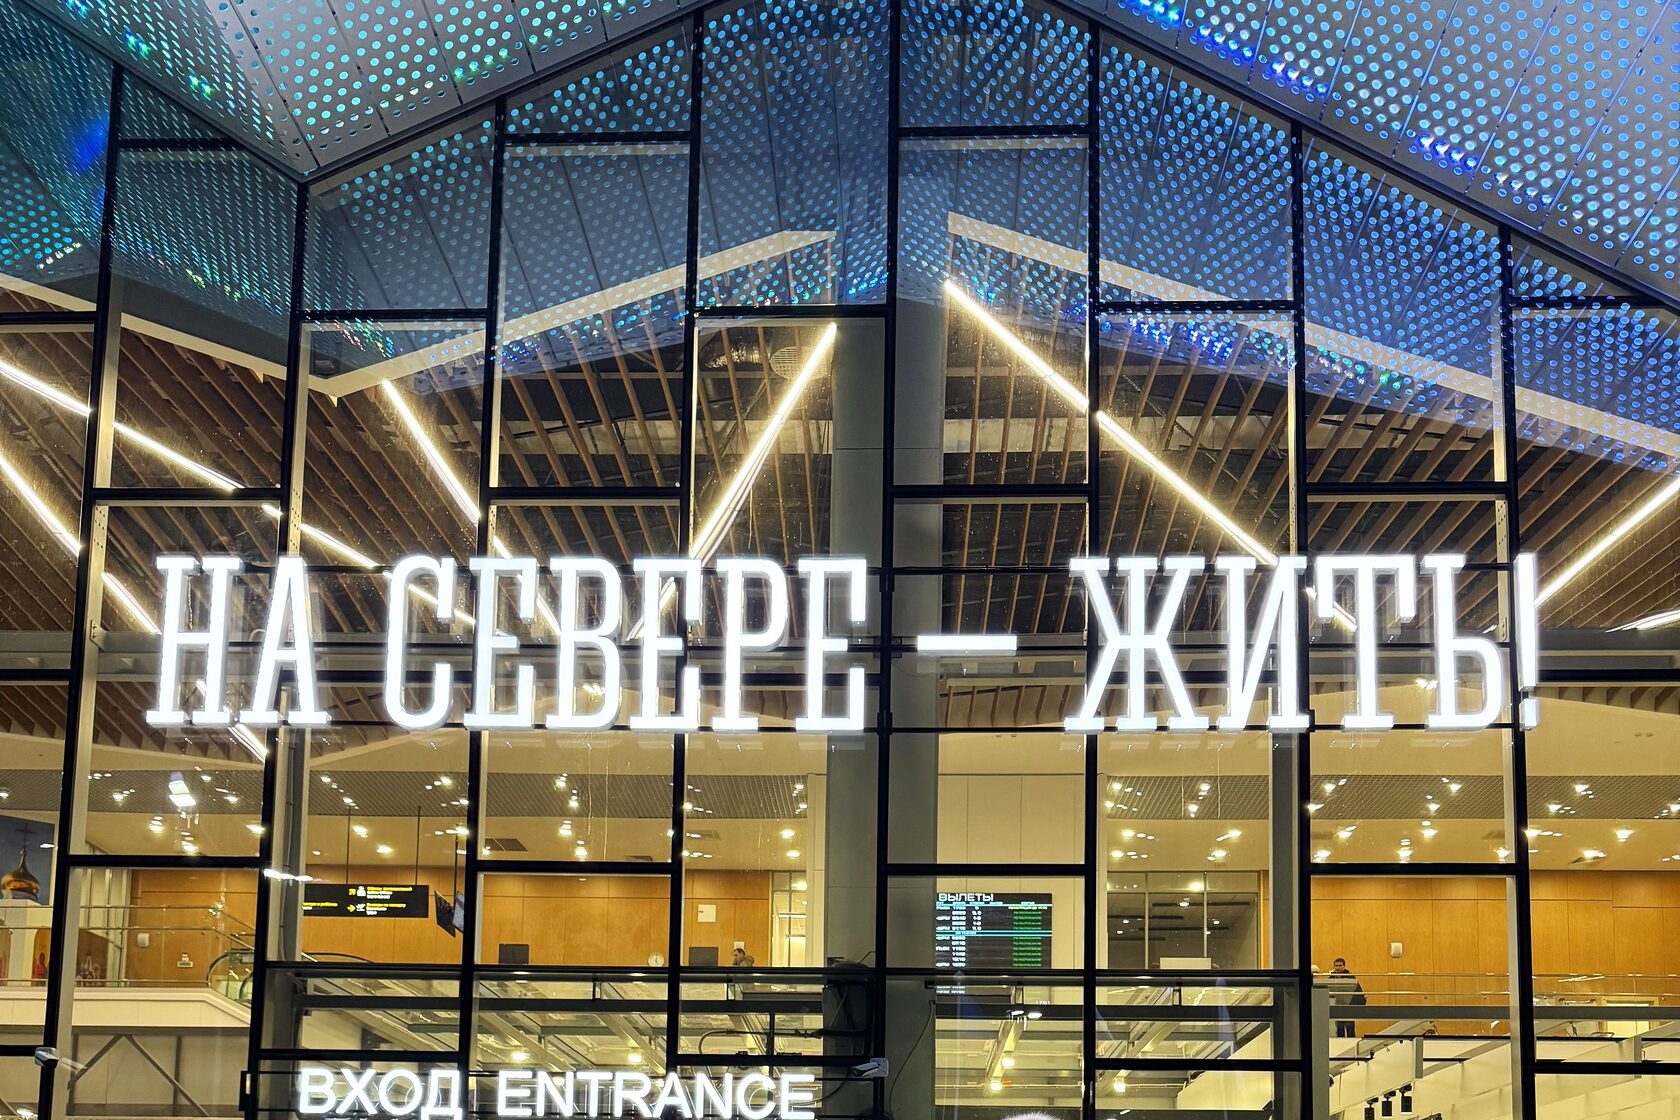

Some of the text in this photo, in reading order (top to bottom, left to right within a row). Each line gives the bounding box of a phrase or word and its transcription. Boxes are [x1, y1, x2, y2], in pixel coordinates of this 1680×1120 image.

[147, 555, 331, 727] НА
[382, 554, 870, 733] СЕВЕРЕ
[1063, 551, 1542, 733] ЖИТЬ!
[938, 893, 994, 902] ВЫЛЕТЫ
